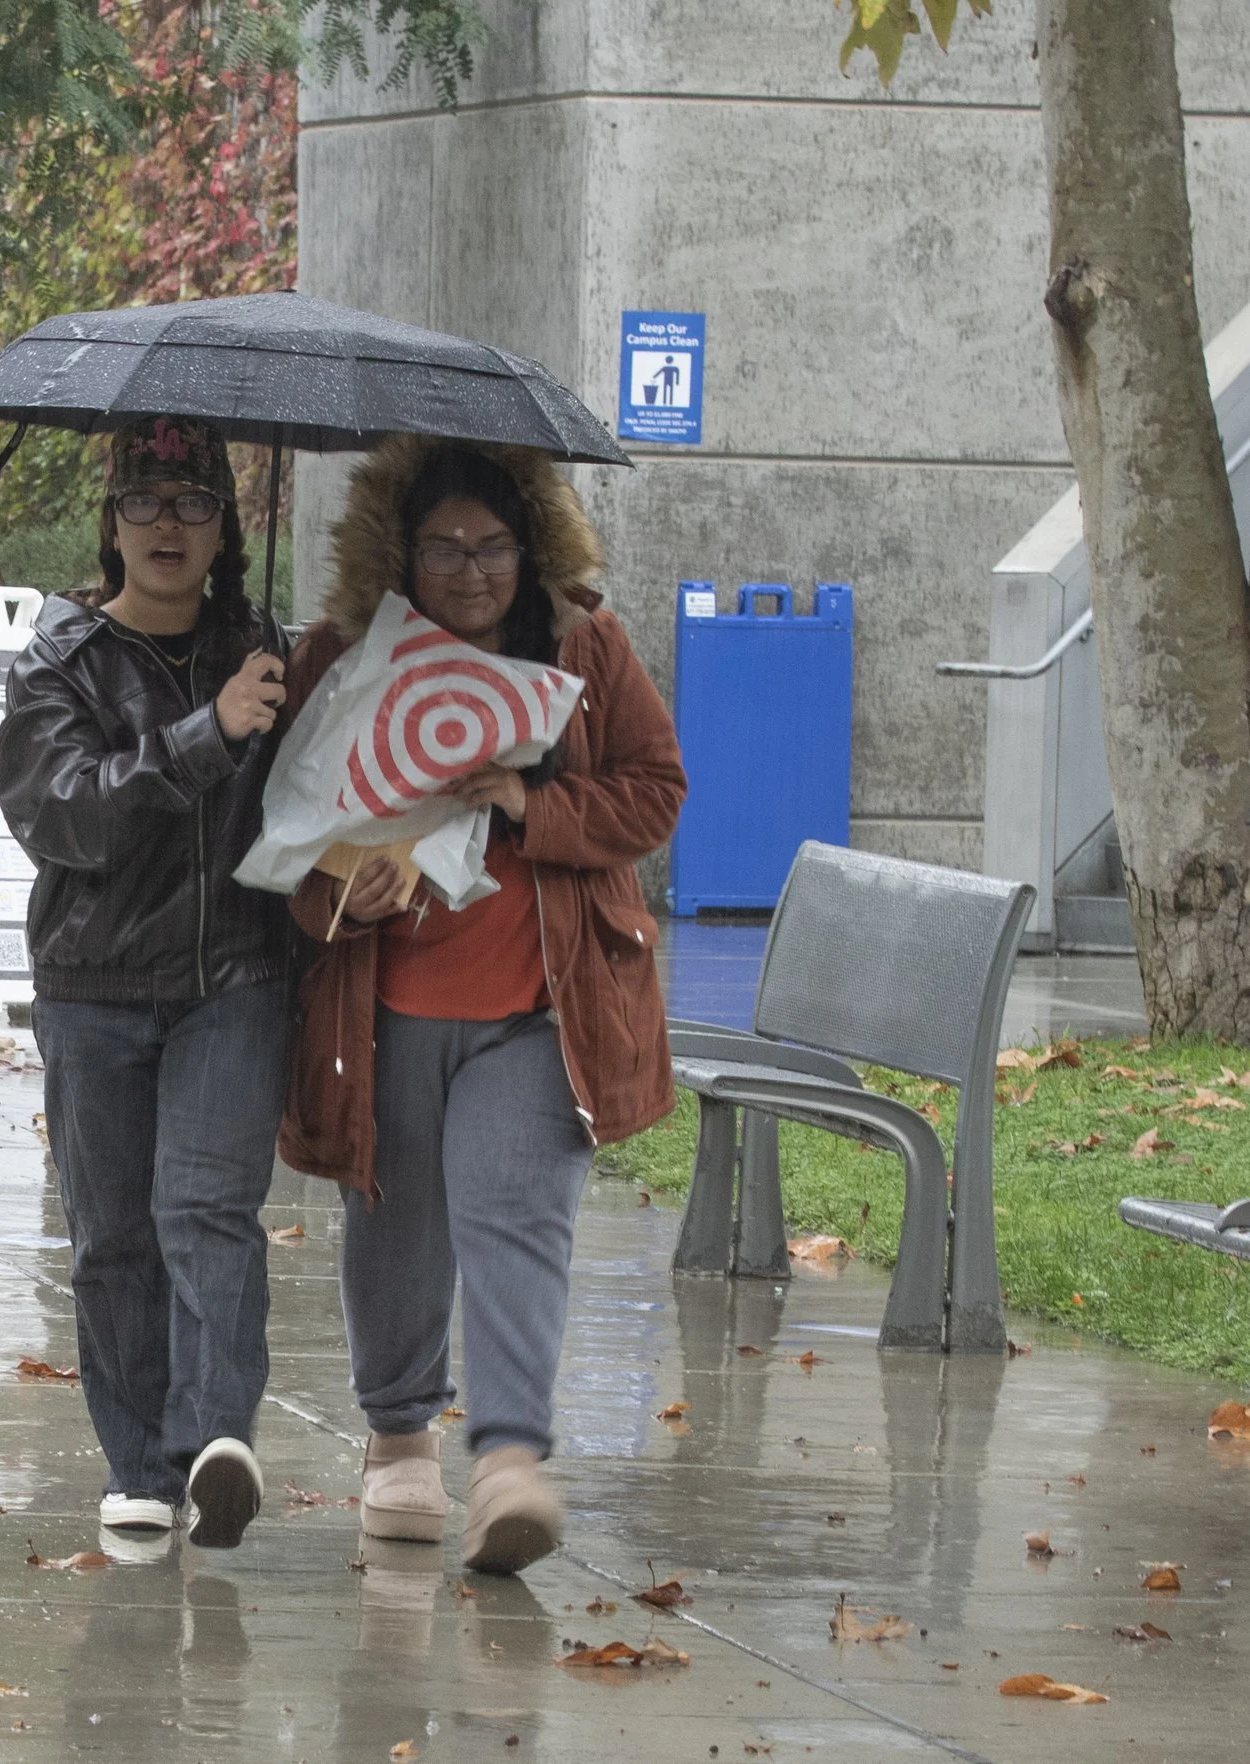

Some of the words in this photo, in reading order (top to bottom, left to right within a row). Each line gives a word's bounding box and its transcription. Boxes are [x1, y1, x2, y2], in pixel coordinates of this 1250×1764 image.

[639, 322, 665, 335] Keep
[667, 323, 687, 334] Our
[626, 333, 668, 347] Campus
[669, 335, 699, 346] Clean
